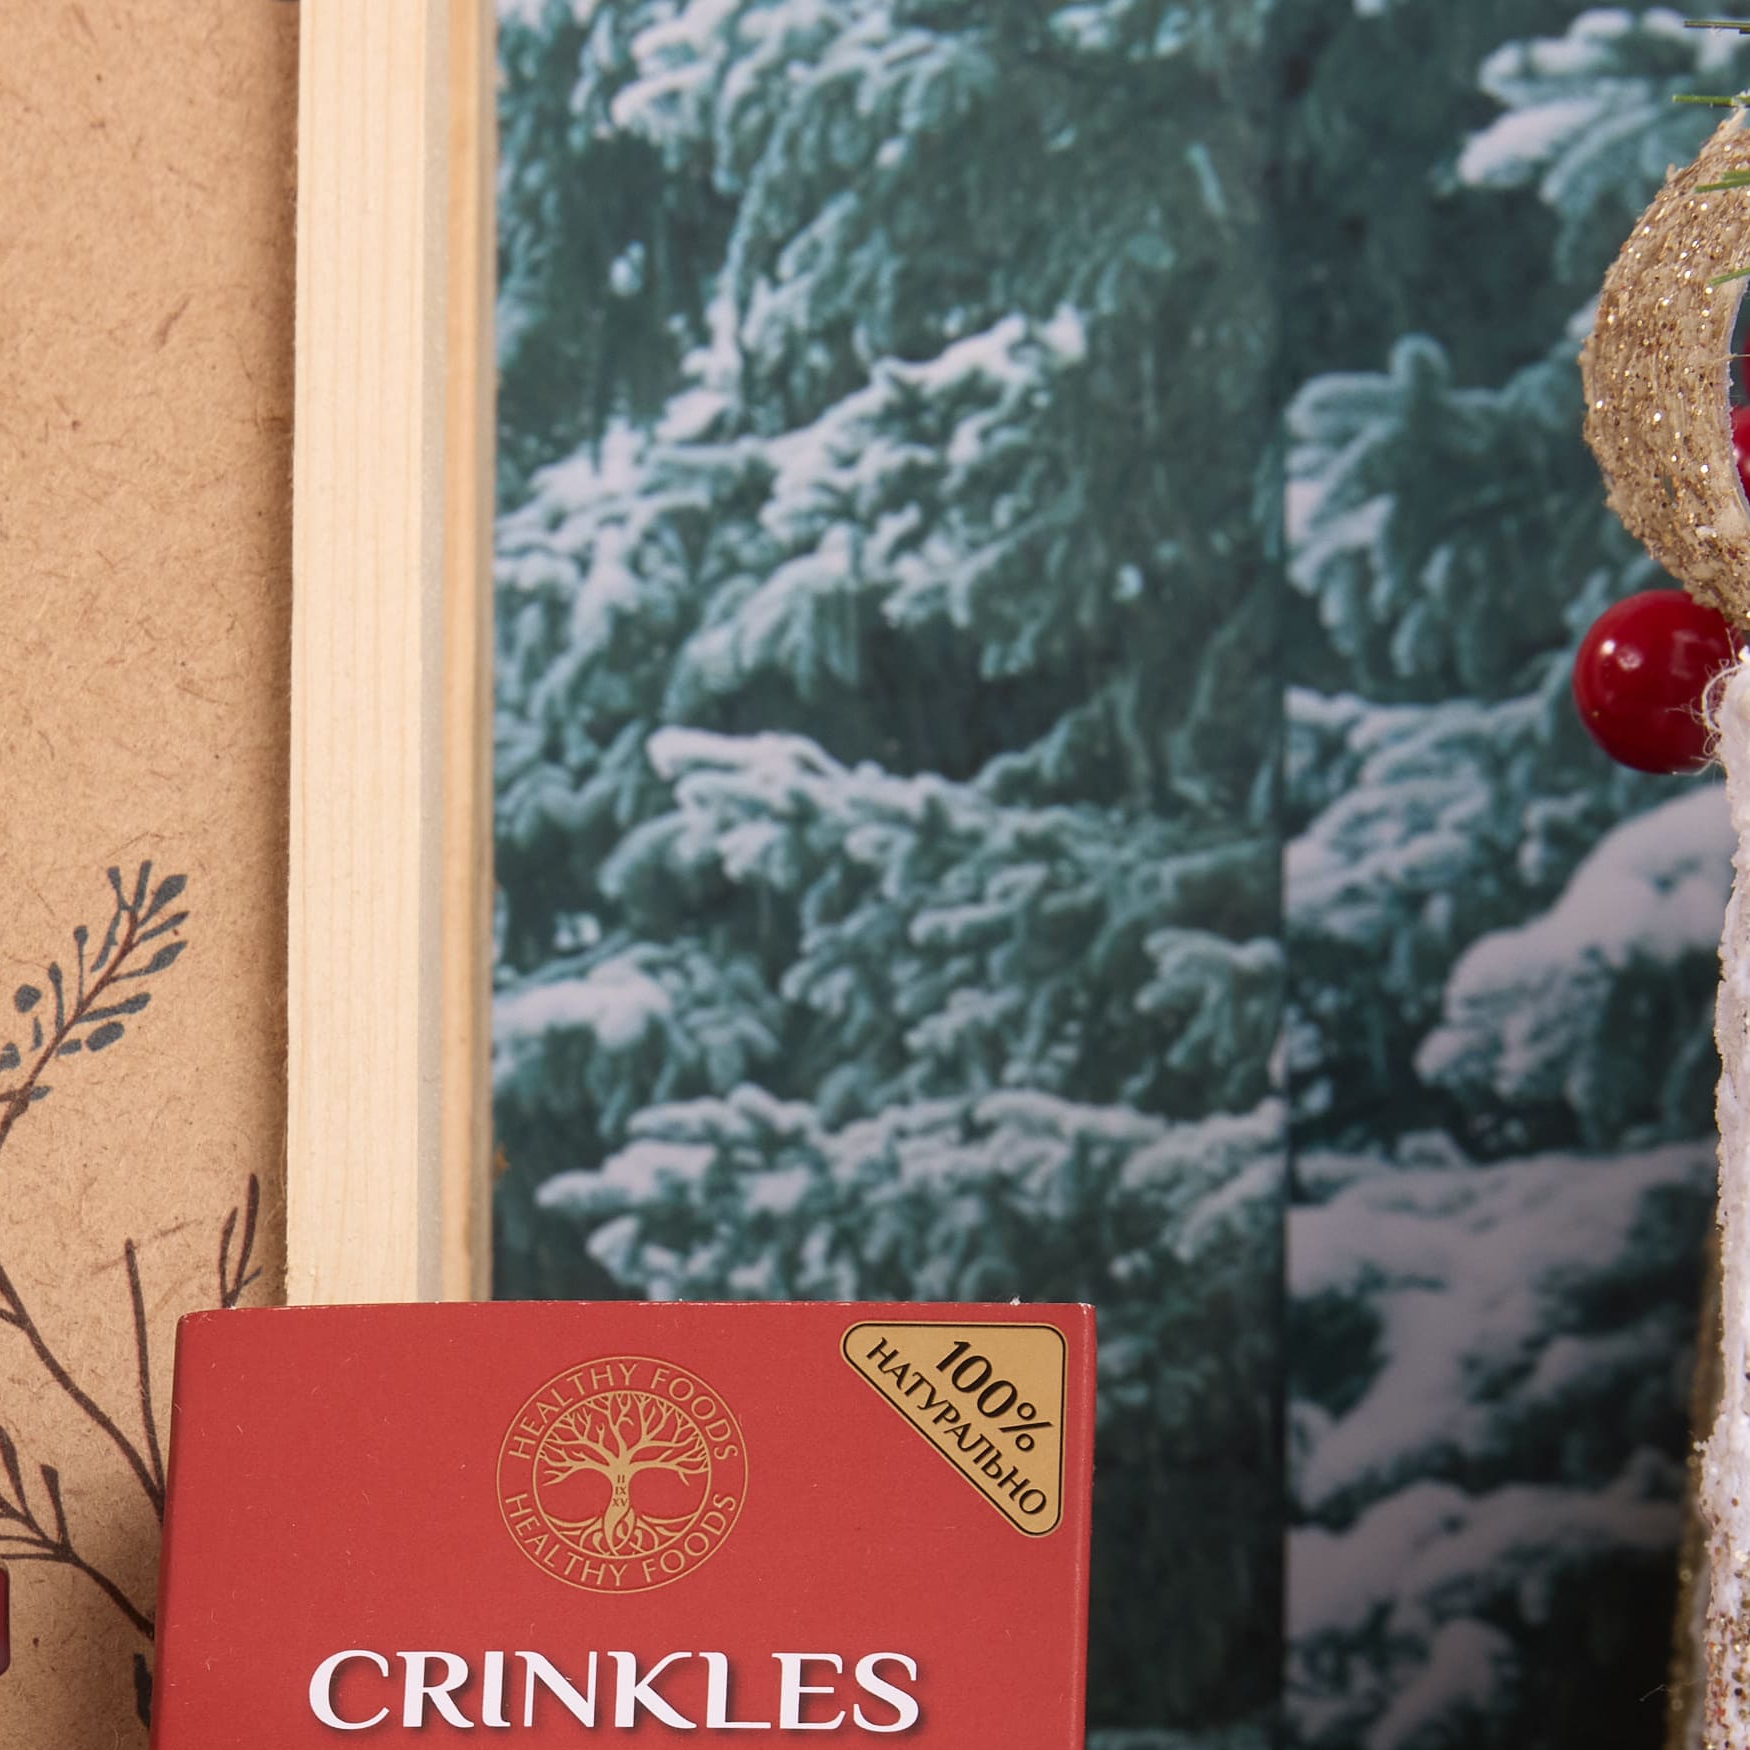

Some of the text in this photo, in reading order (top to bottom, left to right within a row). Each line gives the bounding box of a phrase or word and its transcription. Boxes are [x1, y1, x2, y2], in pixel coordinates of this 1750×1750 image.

[508, 1363, 739, 1460] HEALTHY FOODS
[866, 1336, 1047, 1515] НАТУРАЛЬНО
[935, 1340, 1054, 1452] 100%
[615, 1486, 627, 1495] IX
[505, 1493, 736, 1587] HEALTHY FOODS
[308, 1648, 920, 1733] CRINKLES
